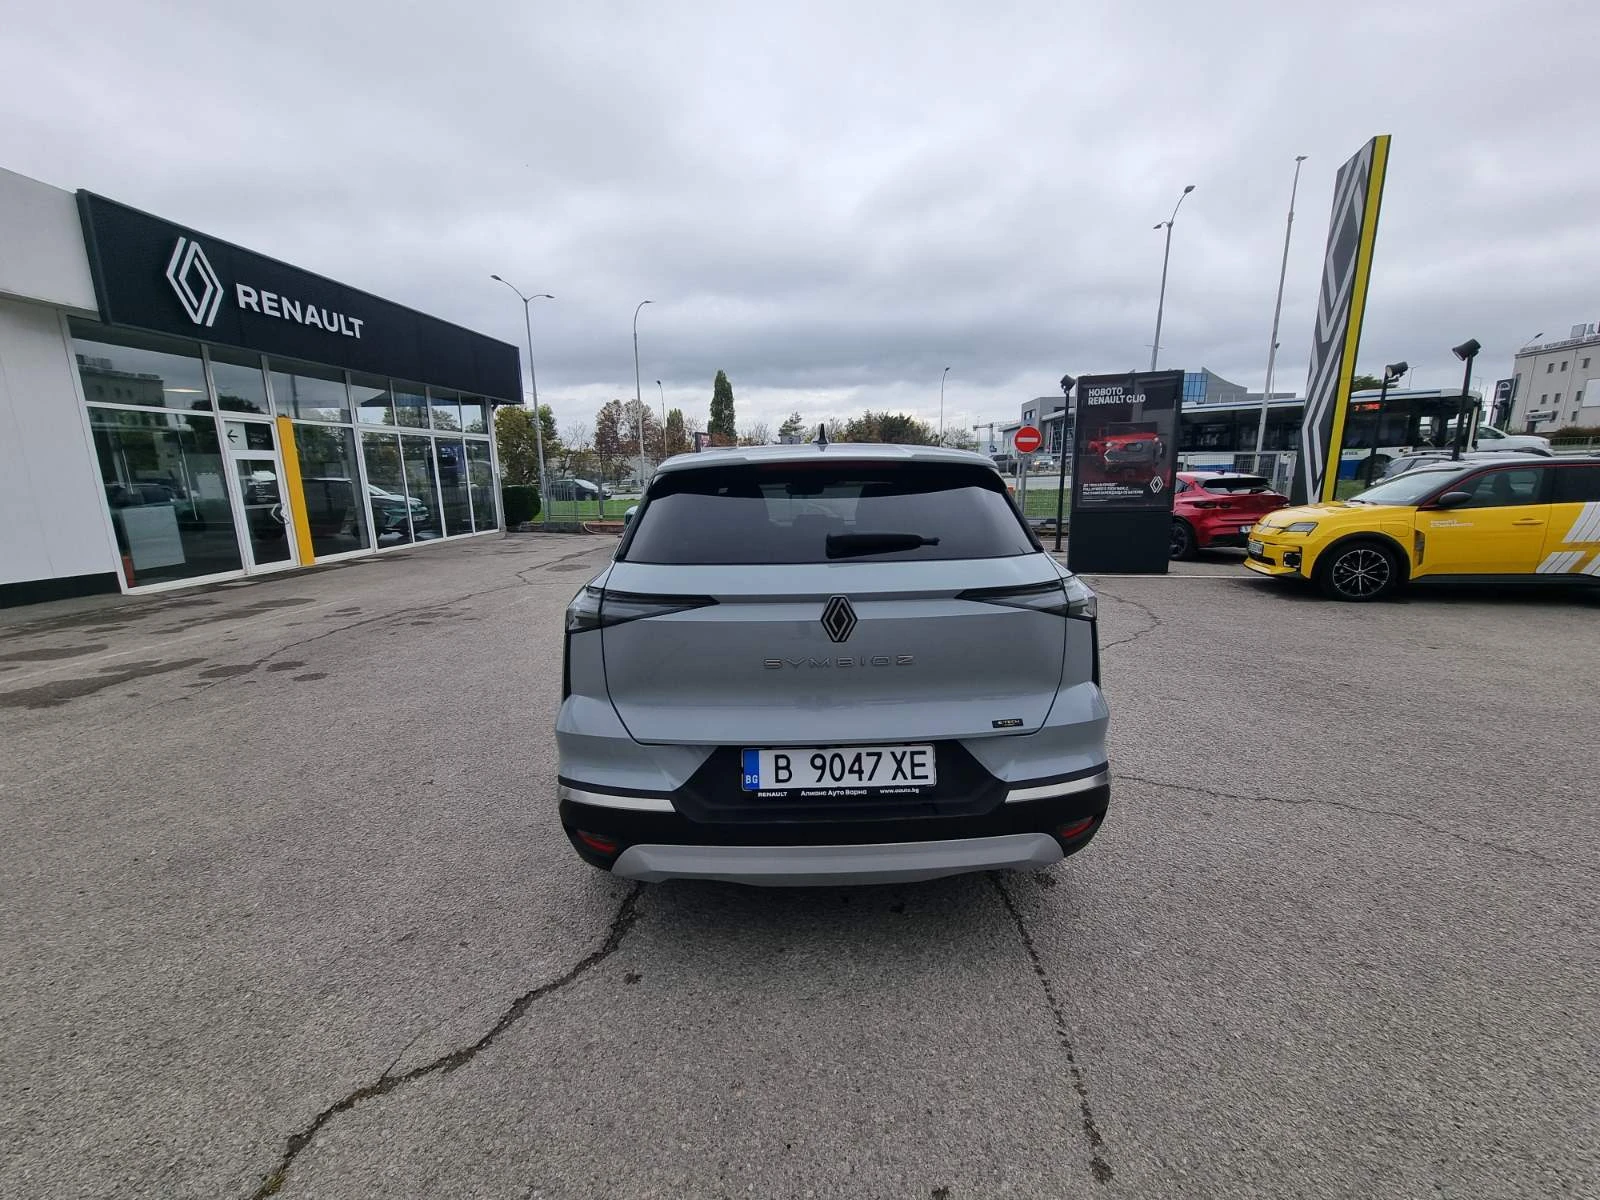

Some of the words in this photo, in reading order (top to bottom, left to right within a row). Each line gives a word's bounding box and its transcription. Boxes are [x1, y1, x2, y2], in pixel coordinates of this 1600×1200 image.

[236, 283, 364, 339] RENAULT
[1088, 387, 1123, 397] НОВОТО
[1088, 395, 1125, 405] RENAULT
[1126, 393, 1146, 403] CLIO
[764, 655, 914, 669] SYMBIOZ
[774, 754, 793, 784] B
[809, 751, 883, 783] 9047
[890, 750, 929, 781] XE
[745, 775, 759, 784] BG
[827, 789, 845, 797] Ауто
